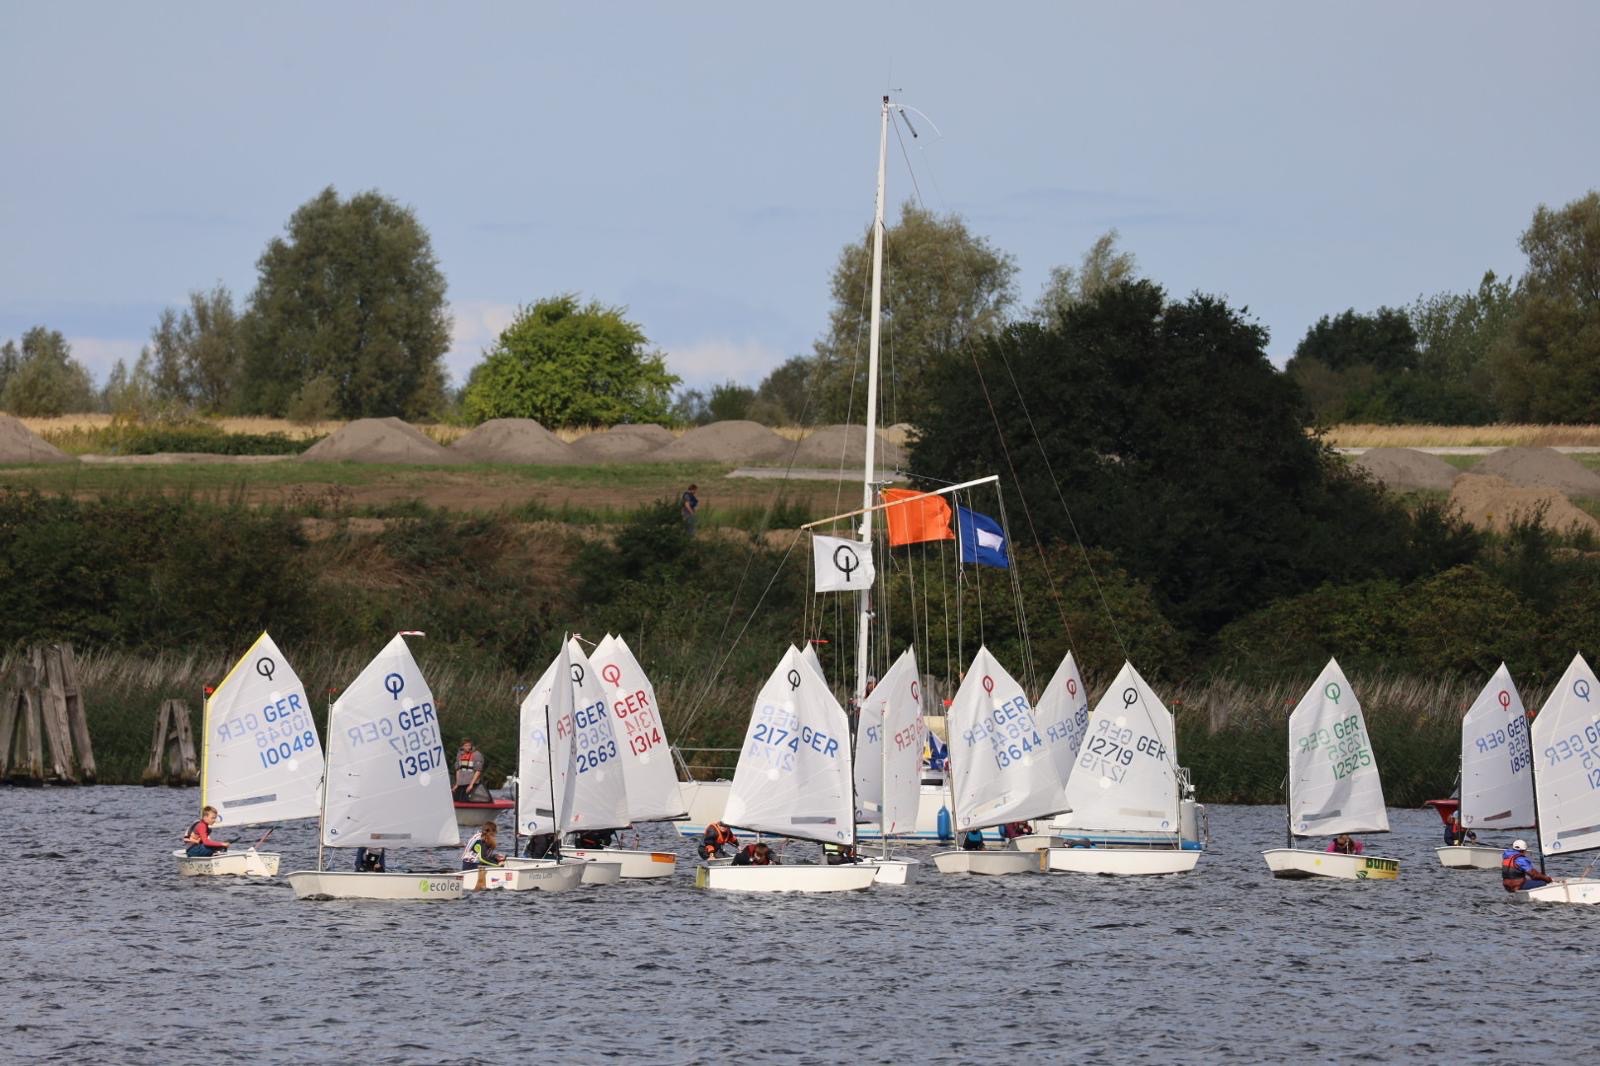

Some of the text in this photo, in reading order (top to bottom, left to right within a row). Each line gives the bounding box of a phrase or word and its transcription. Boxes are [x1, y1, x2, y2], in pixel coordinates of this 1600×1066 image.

[264, 693, 302, 722] GER
[398, 702, 435, 731] GER
[575, 701, 607, 729] GER
[614, 690, 649, 719] GER
[993, 695, 1029, 726] GER
[752, 723, 801, 752] 2174
[1333, 714, 1360, 740] GER
[1507, 714, 1527, 738] GER
[260, 731, 315, 768] 10048
[629, 727, 662, 756] 1314
[802, 726, 839, 758] GER
[996, 730, 1043, 770] 13644
[1087, 735, 1134, 766] 12719
[1136, 735, 1166, 762] GER
[398, 746, 443, 778] 13617
[577, 740, 617, 775] 2663
[1332, 750, 1371, 781] 12525
[1510, 749, 1530, 775] 1856
[430, 880, 460, 892] ecolea
